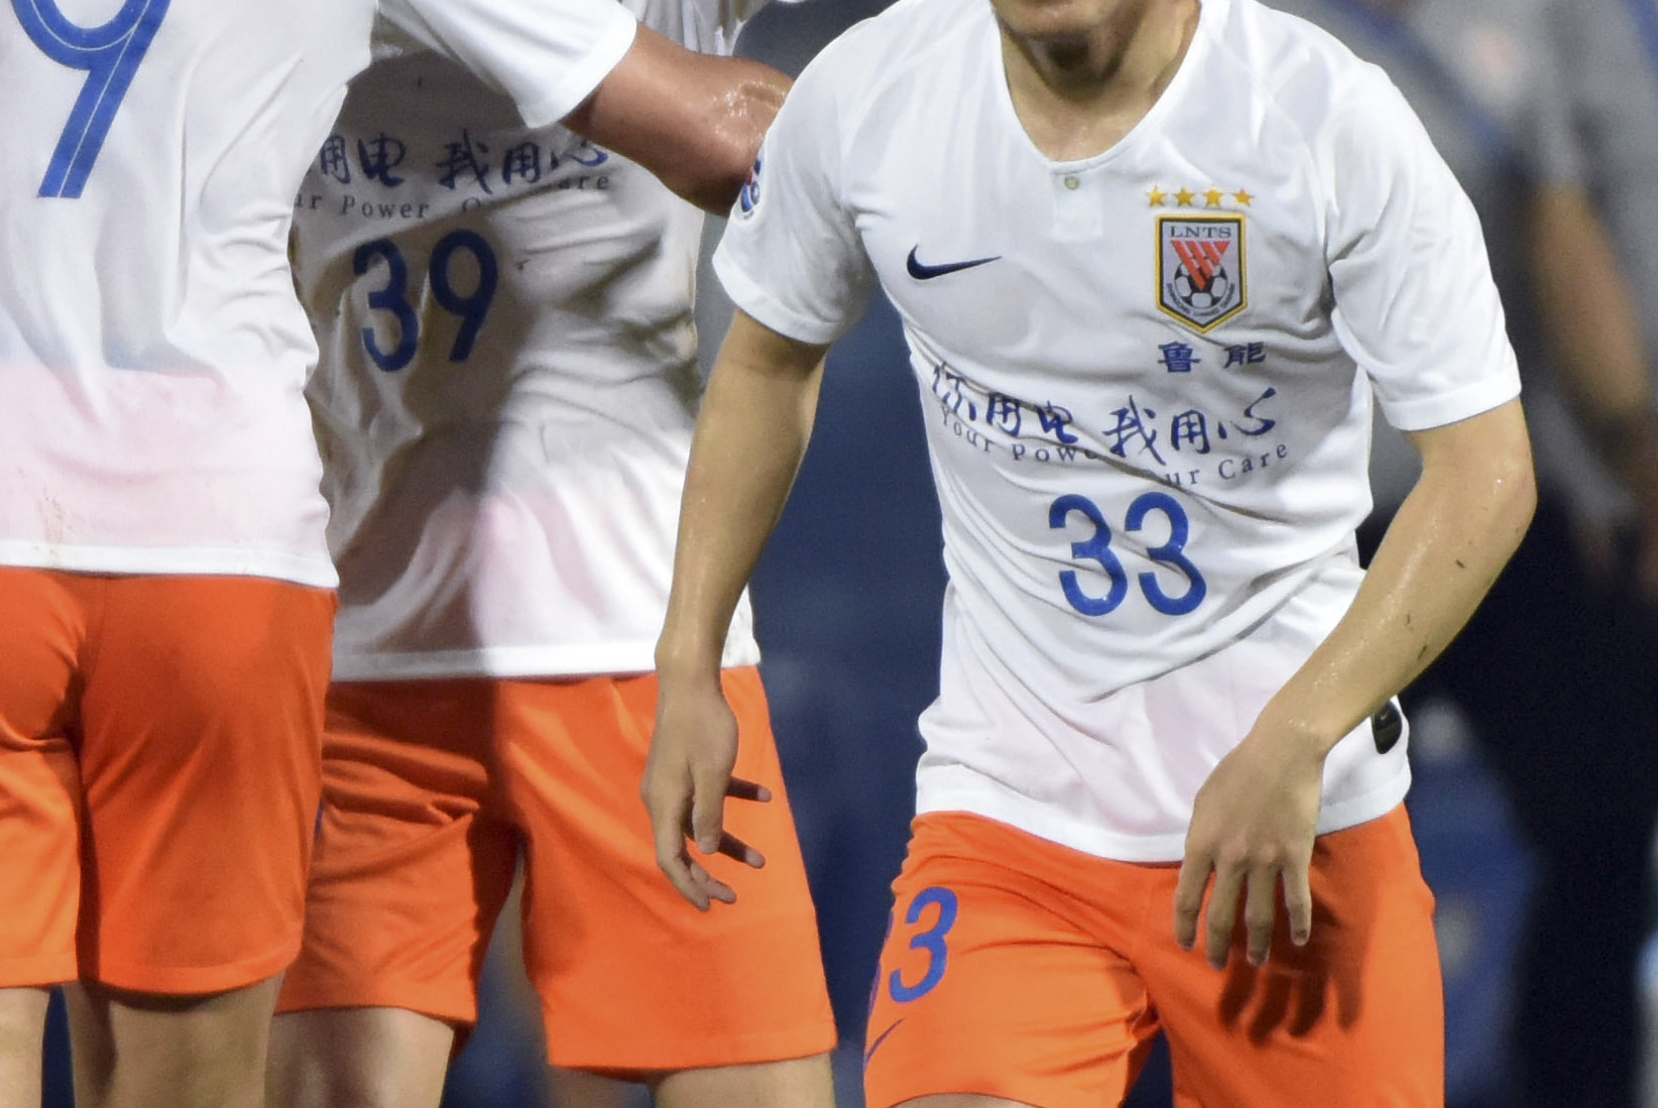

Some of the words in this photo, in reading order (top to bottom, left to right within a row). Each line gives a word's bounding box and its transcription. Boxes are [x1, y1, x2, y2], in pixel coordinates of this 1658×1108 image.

[306, 132, 406, 187] 用电
[341, 194, 431, 219] Power
[557, 173, 609, 190] are
[1170, 225, 1232, 238] LNTS
[352, 228, 500, 373] 39
[1157, 341, 1267, 373] 鲁能
[1102, 387, 1278, 466] 我用心
[1011, 443, 1098, 462] Pow
[1218, 443, 1289, 480] Care
[1048, 492, 1207, 617] 33
[869, 886, 959, 1012] 3
